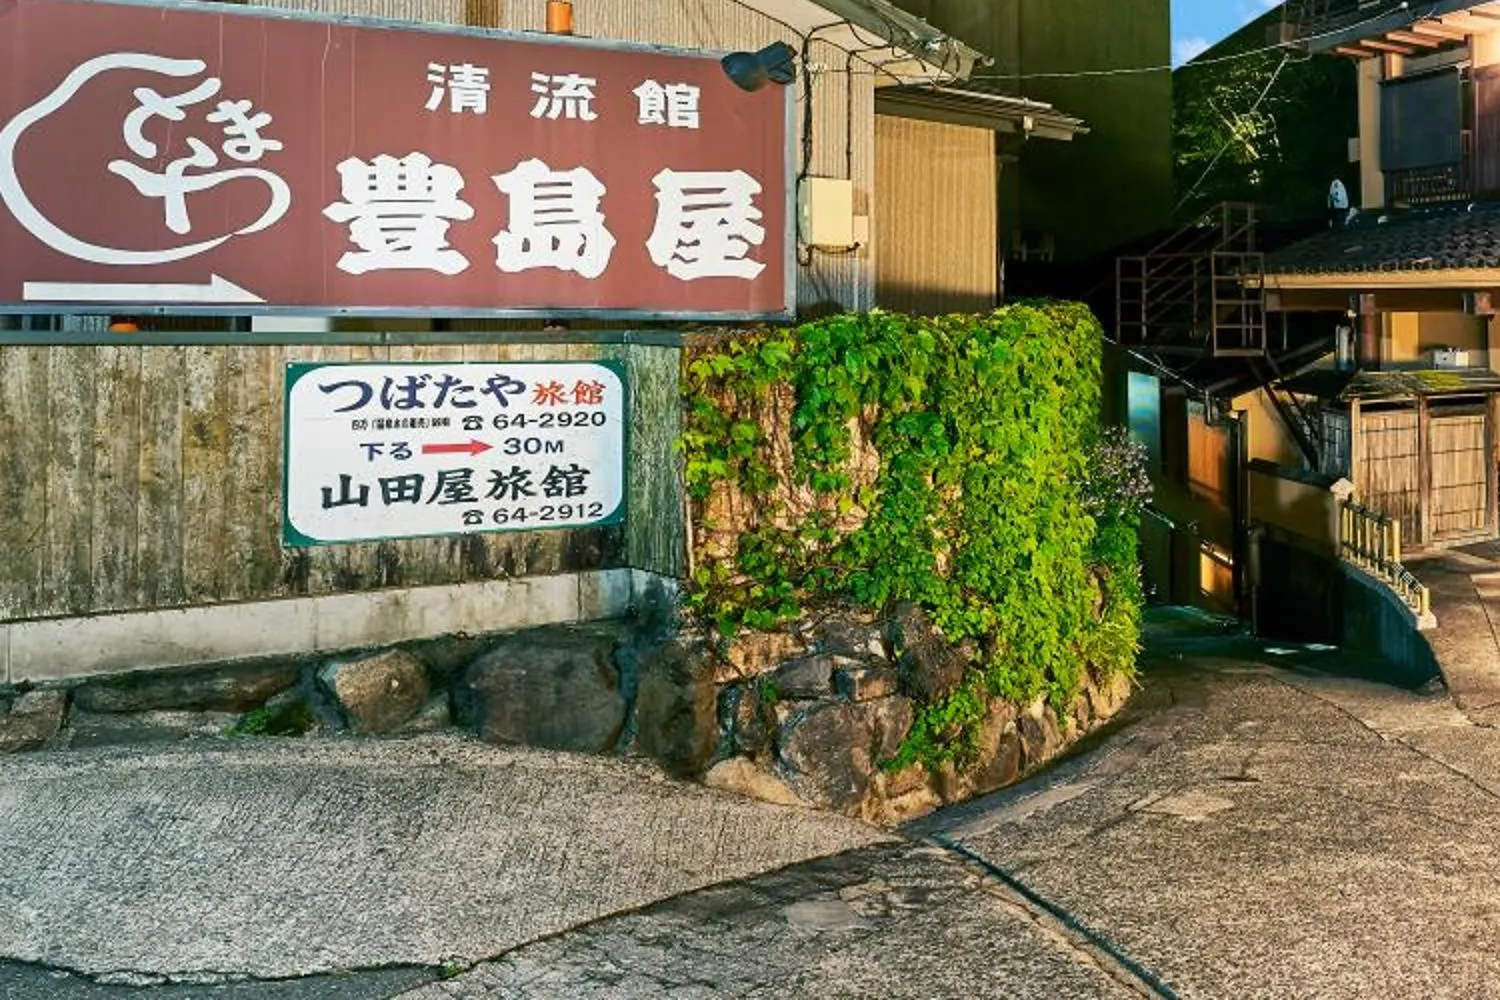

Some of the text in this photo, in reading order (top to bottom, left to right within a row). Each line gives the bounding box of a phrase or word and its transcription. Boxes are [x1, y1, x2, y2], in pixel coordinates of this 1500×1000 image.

[425, 62, 700, 129] 清流館
[321, 151, 767, 280] 豊島屋
[492, 411, 607, 429] 64-2920
[359, 441, 413, 462] 下る
[492, 502, 604, 525] 64-2912
